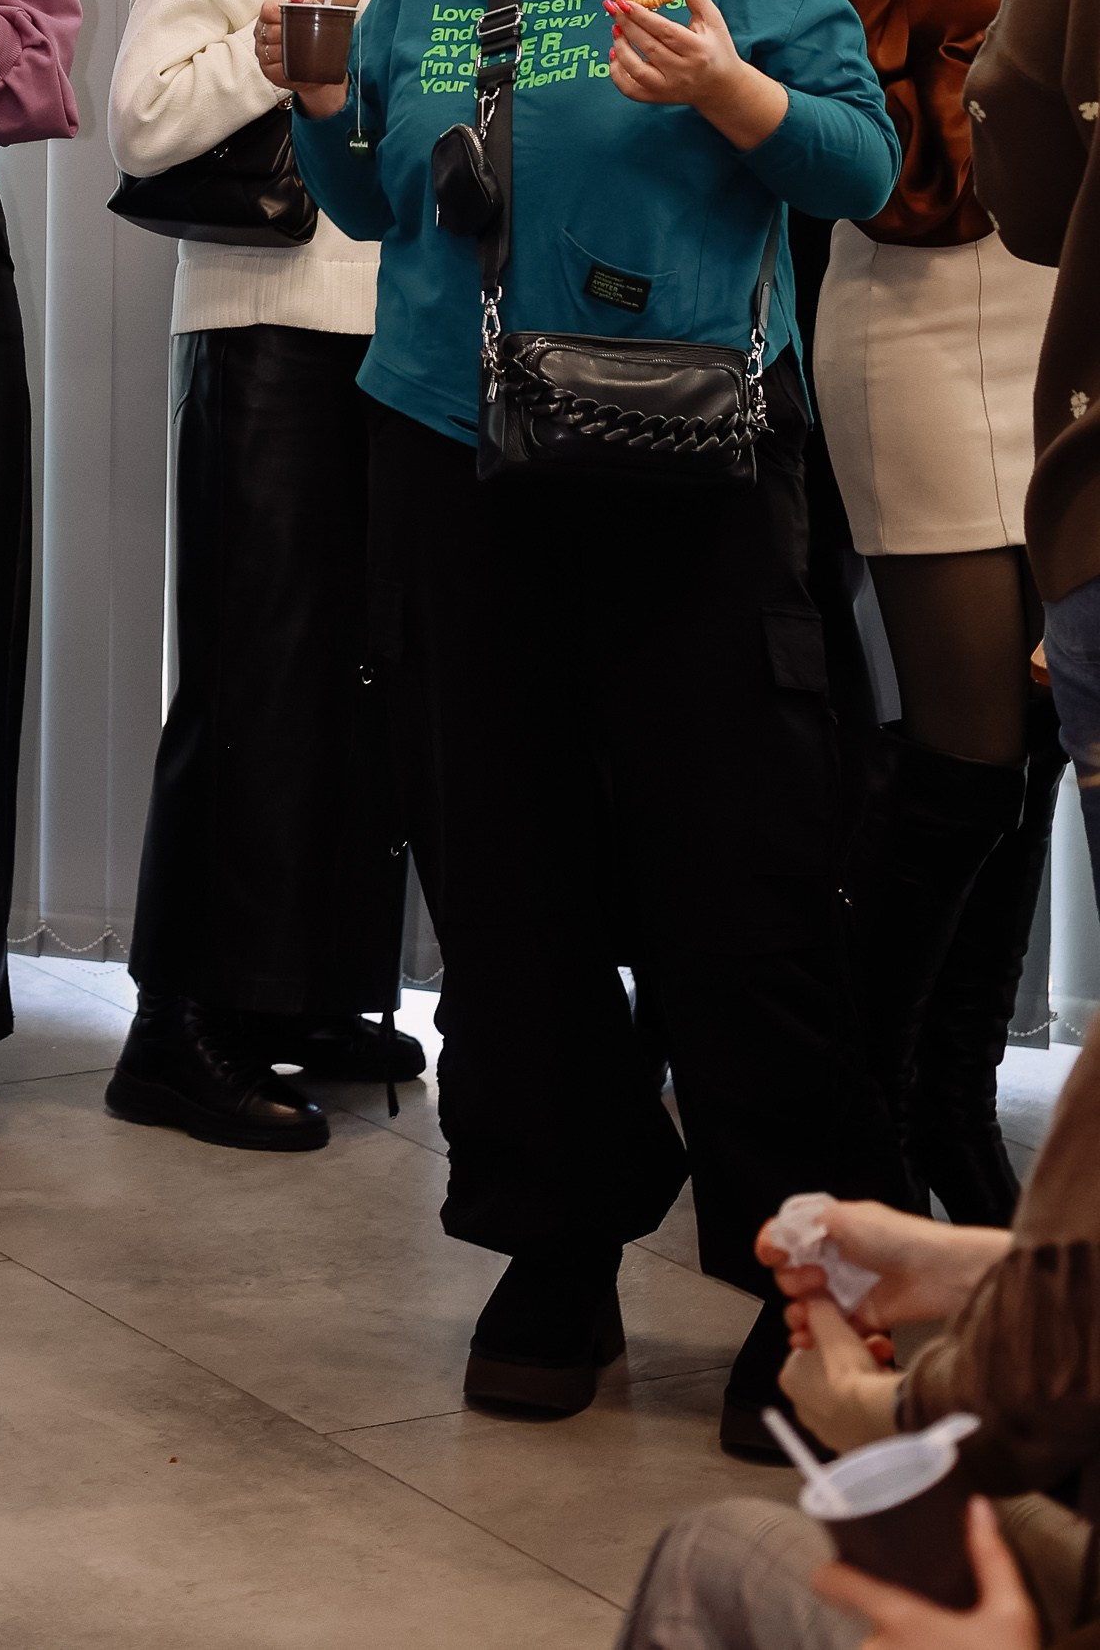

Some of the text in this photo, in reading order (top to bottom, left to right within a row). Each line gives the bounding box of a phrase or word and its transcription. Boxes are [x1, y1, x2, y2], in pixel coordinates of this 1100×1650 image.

[432, 4, 485, 22] Love
[430, 24, 475, 42] and
[533, 12, 597, 29] away
[423, 32, 563, 61] AYER
[420, 59, 454, 77] I'm
[420, 77, 470, 95] Your
